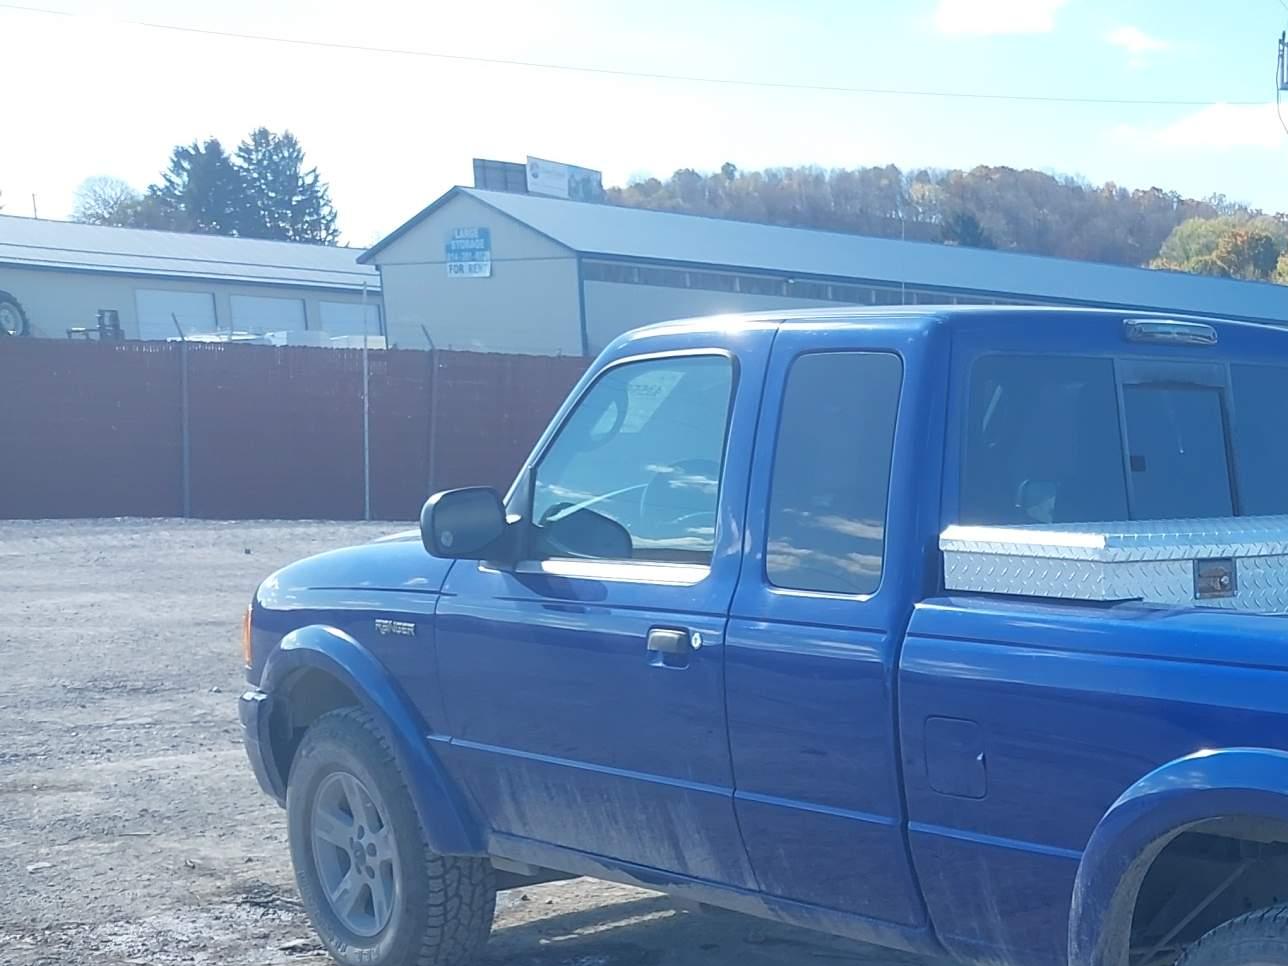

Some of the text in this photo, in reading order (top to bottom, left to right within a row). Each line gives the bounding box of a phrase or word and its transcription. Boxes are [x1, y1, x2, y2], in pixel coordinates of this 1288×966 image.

[451, 239, 485, 250] STORAGE
[448, 263, 465, 274] FOR
[468, 263, 489, 274] RENT
[375, 620, 416, 637] RANGER
